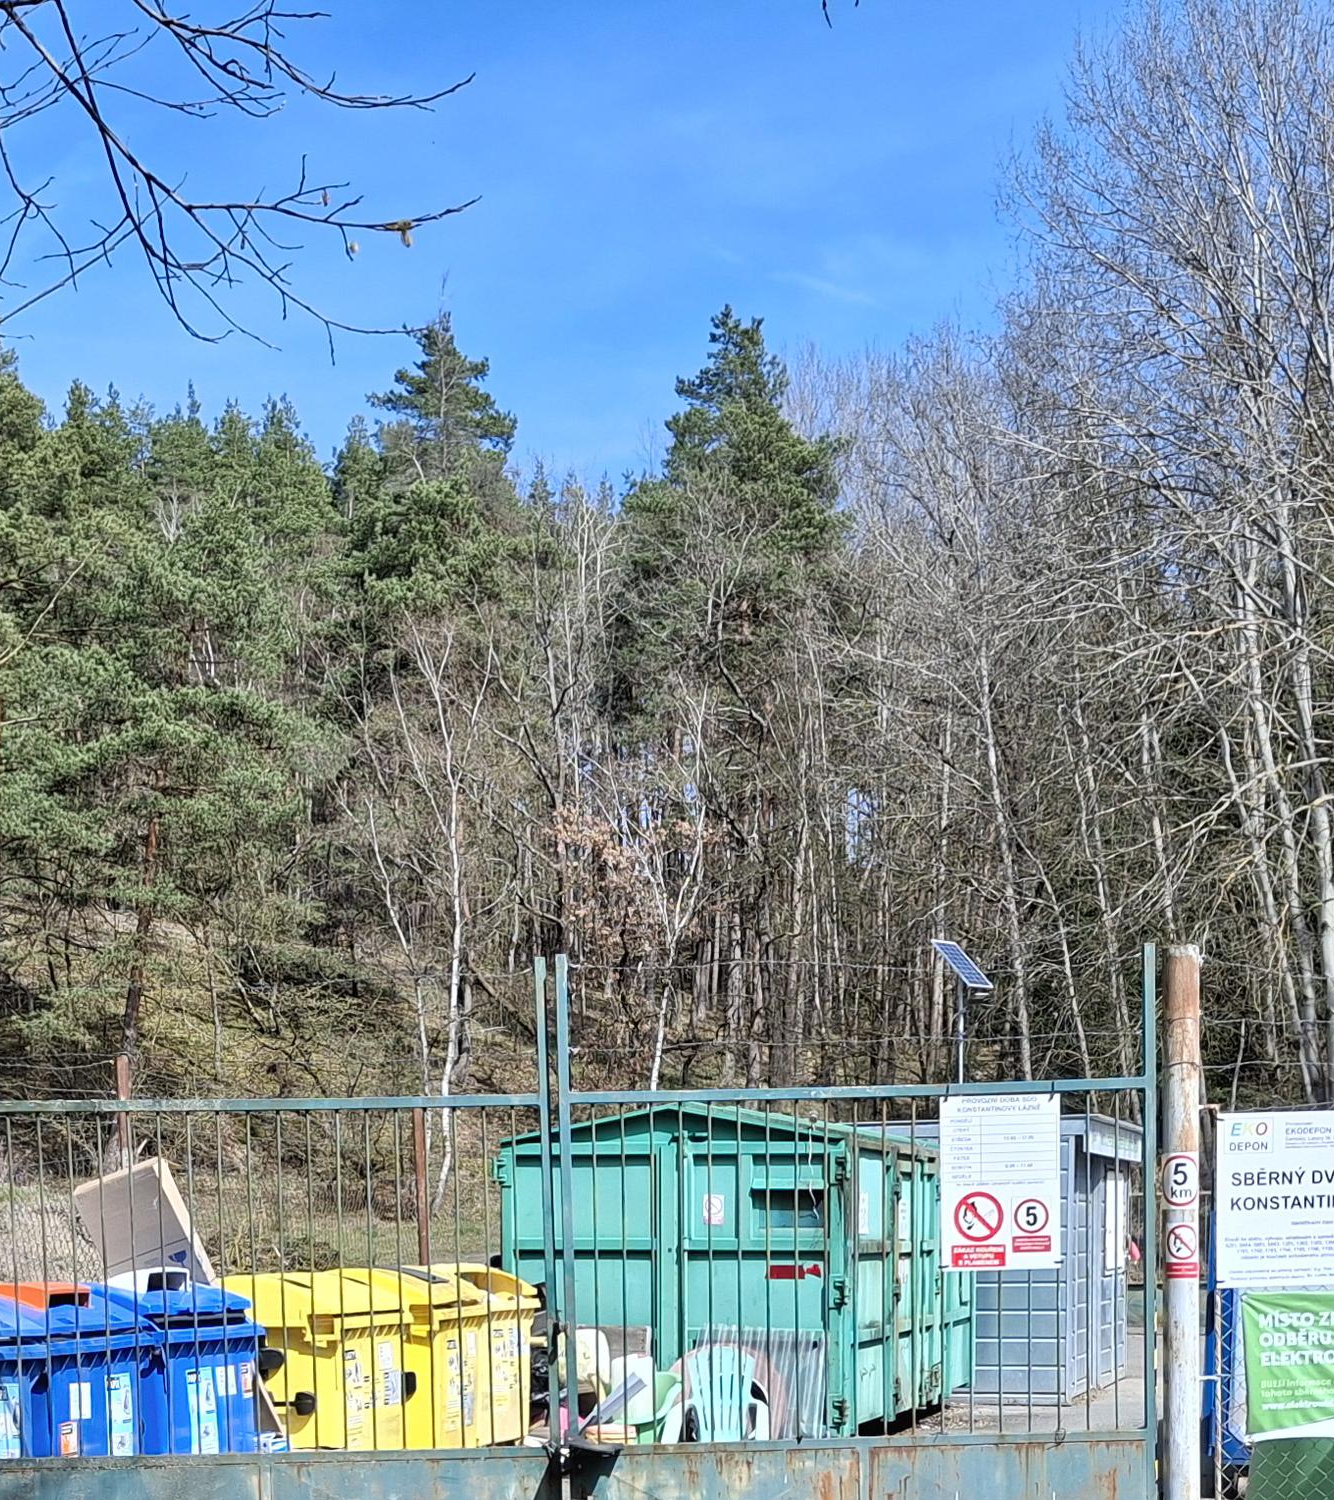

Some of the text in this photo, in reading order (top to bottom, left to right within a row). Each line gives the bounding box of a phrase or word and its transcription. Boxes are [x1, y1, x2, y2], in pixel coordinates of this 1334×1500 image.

[1231, 1121, 1268, 1137] EKO
[1229, 1141, 1268, 1151] DEPON
[1173, 1162, 1187, 1186] 5
[1231, 1166, 1305, 1187] SBĚRNÝ
[1170, 1187, 1193, 1199] km
[1025, 1206, 1038, 1227] 5
[1259, 1309, 1315, 1328] MÍSTO
[1259, 1328, 1333, 1347] ODBĚRU
